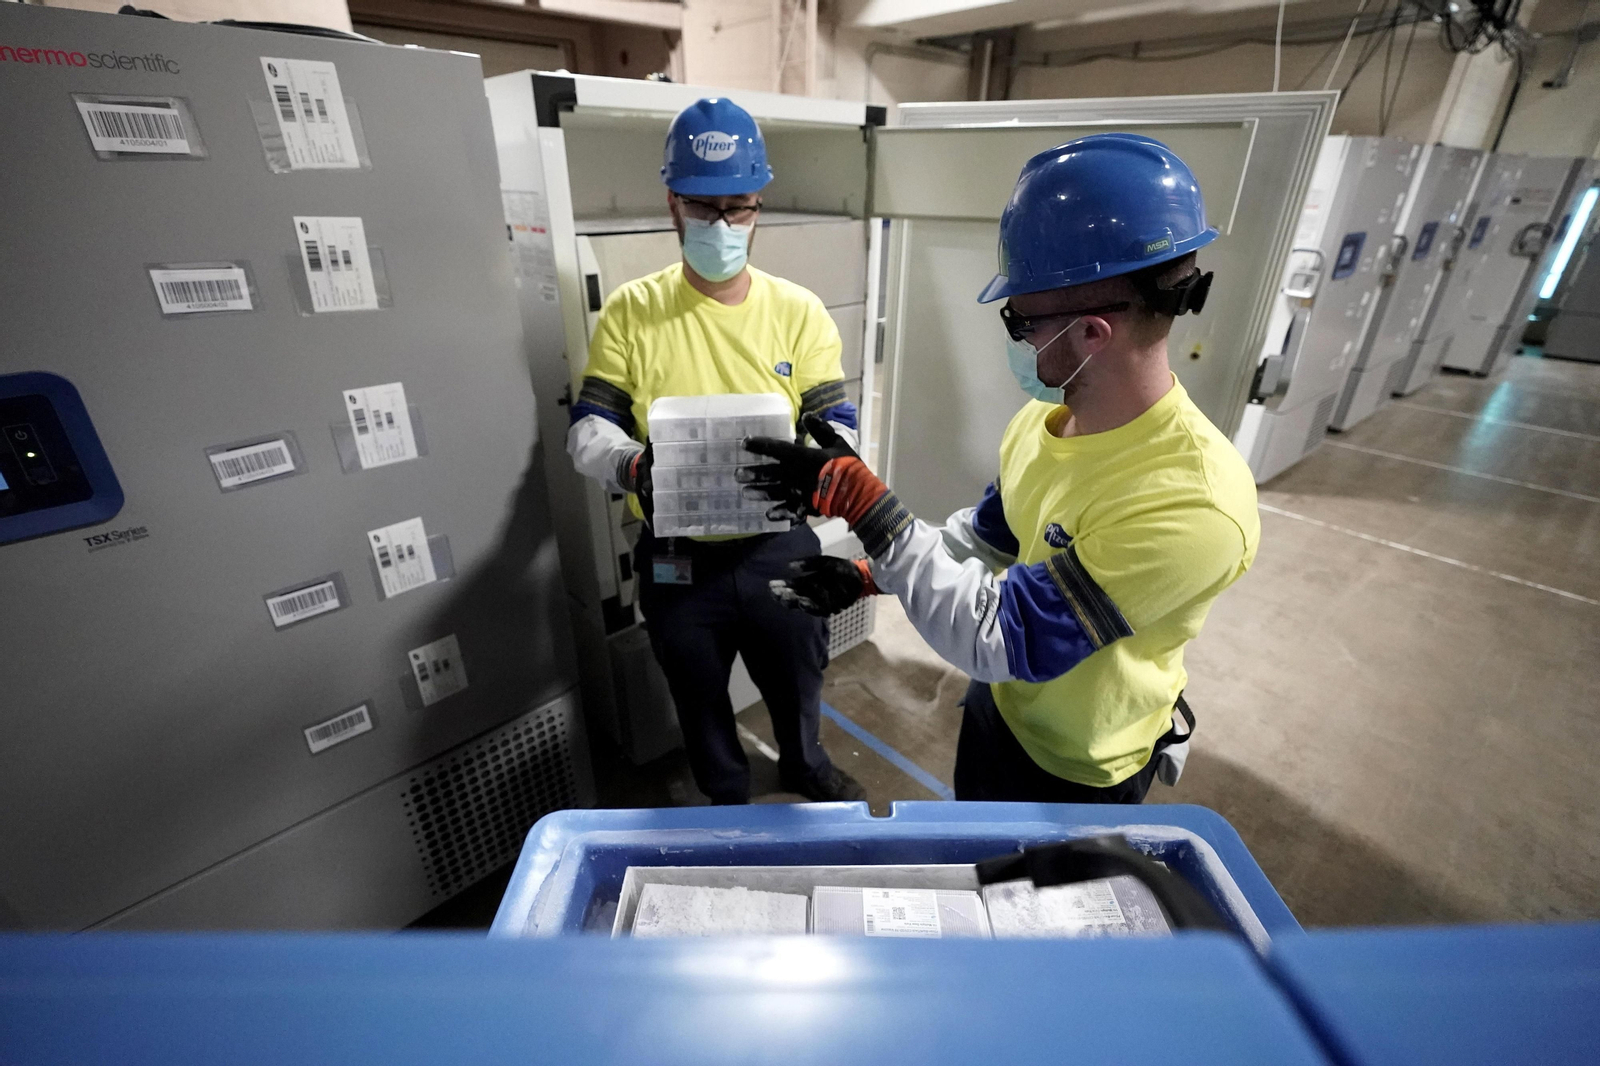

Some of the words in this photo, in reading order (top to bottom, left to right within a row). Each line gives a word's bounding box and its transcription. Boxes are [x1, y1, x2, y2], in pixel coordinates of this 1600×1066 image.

[695, 134, 735, 159] Pfizer
[1147, 239, 1169, 253] MSA
[83, 532, 112, 547] TSX
[1045, 523, 1069, 546] Pfize
